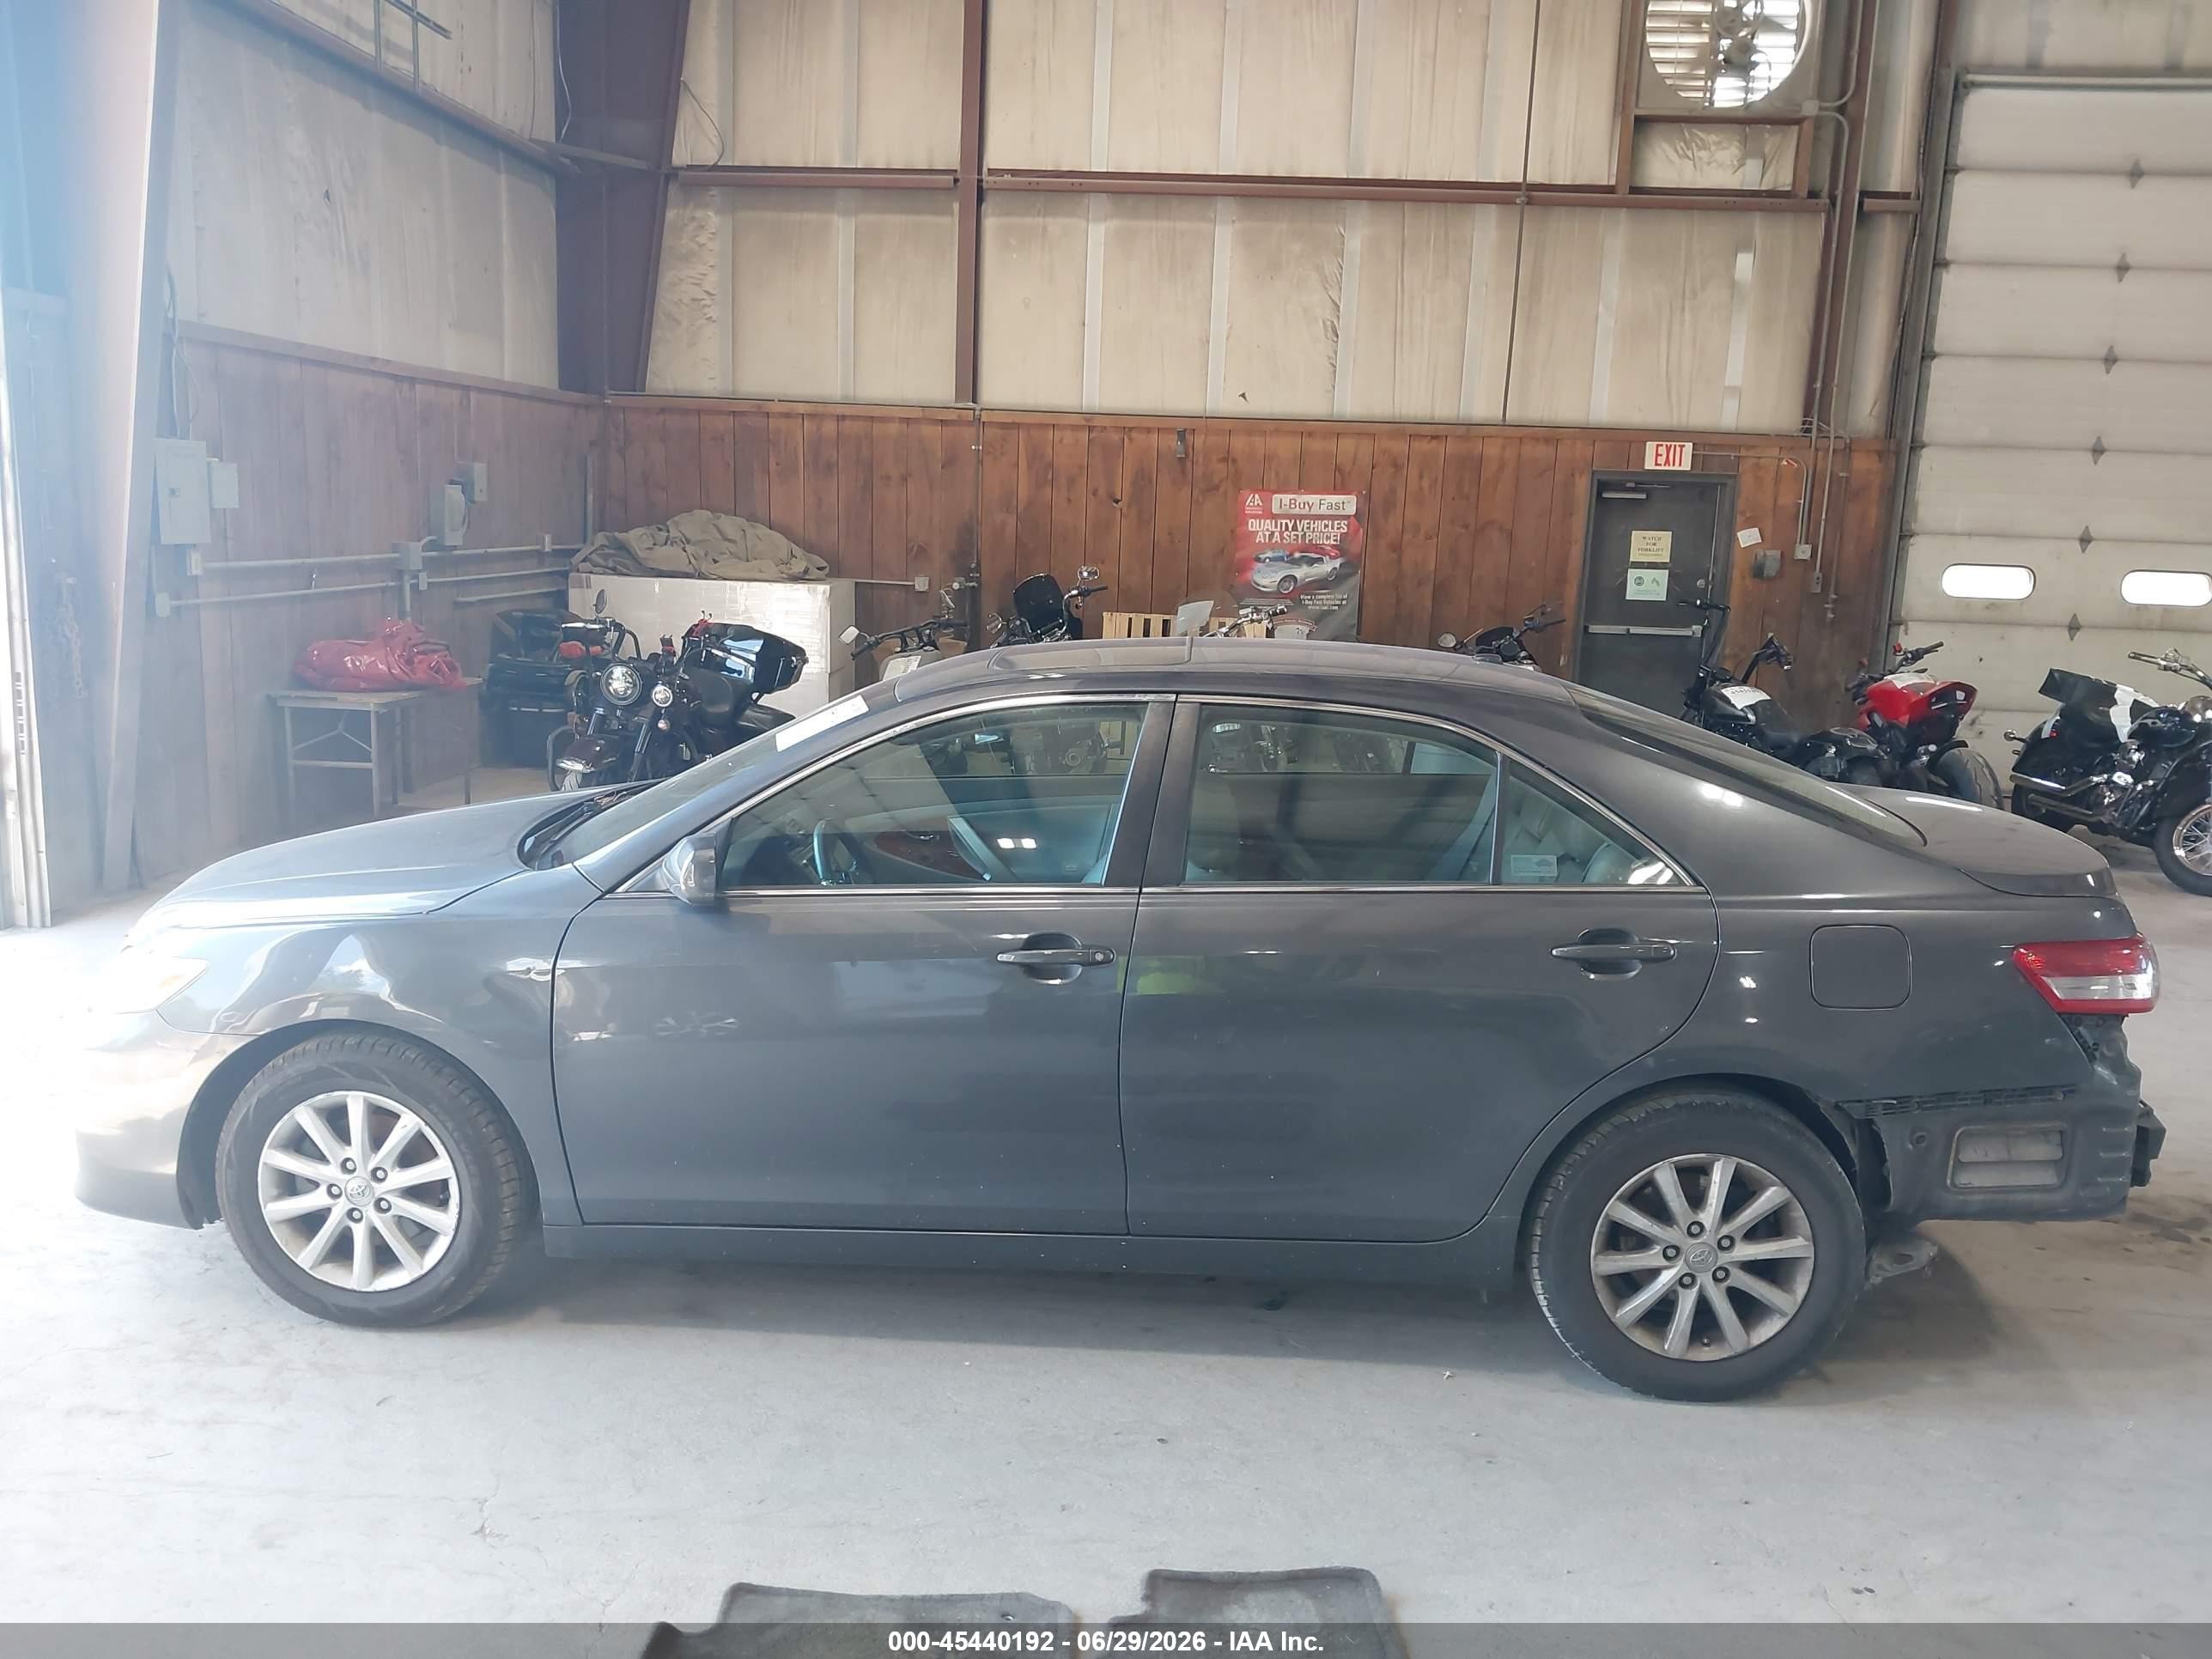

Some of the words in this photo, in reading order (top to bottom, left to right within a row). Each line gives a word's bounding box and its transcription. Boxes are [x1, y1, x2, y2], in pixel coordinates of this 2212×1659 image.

[1654, 443, 1686, 467] EXIT
[1279, 498, 1314, 512] I-Buy
[1318, 499, 1346, 511] Fast
[1248, 519, 1295, 532] QUALITY
[1296, 520, 1348, 532] VEHICLES
[1255, 532, 1271, 543] AT
[1271, 532, 1281, 543] A
[1283, 532, 1304, 544] SET
[1305, 532, 1340, 544] PRICE!
